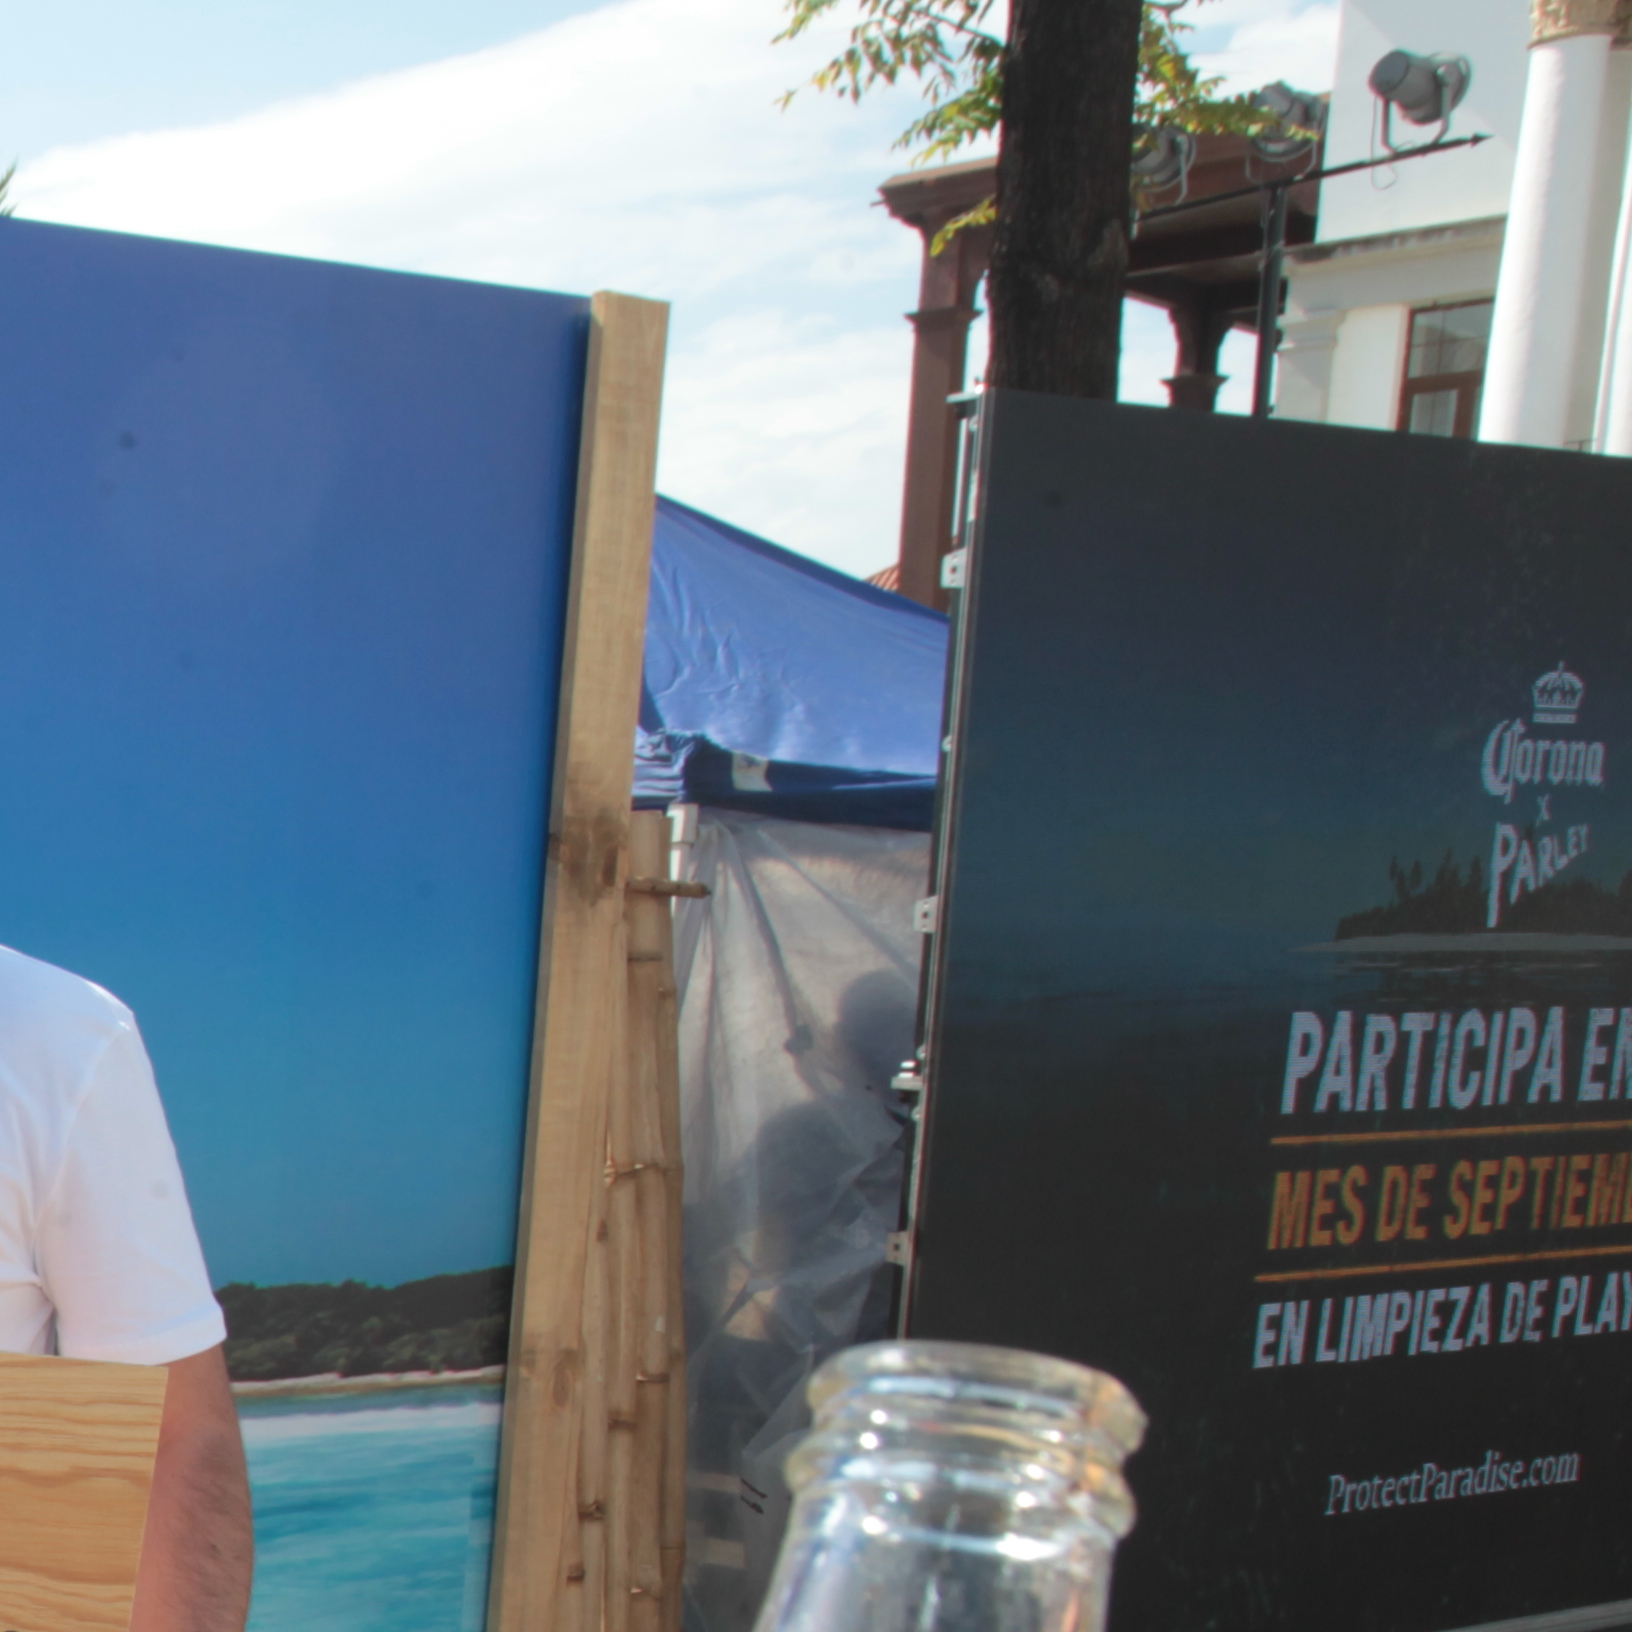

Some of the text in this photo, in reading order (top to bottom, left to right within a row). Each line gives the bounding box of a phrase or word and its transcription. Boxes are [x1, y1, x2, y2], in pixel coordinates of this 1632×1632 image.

[1481, 717, 1606, 804] Corona
[1486, 821, 1590, 928] PARLEY
[1280, 1006, 1566, 1115] PARTICIPA
[1267, 1152, 1632, 1251] MES DE SEPTIEM
[1252, 1300, 1311, 1370] EN
[1314, 1283, 1492, 1363] LIMPIEZA
[1499, 1279, 1549, 1345] DE
[1325, 1450, 1581, 1516] ProtectParadise.com
